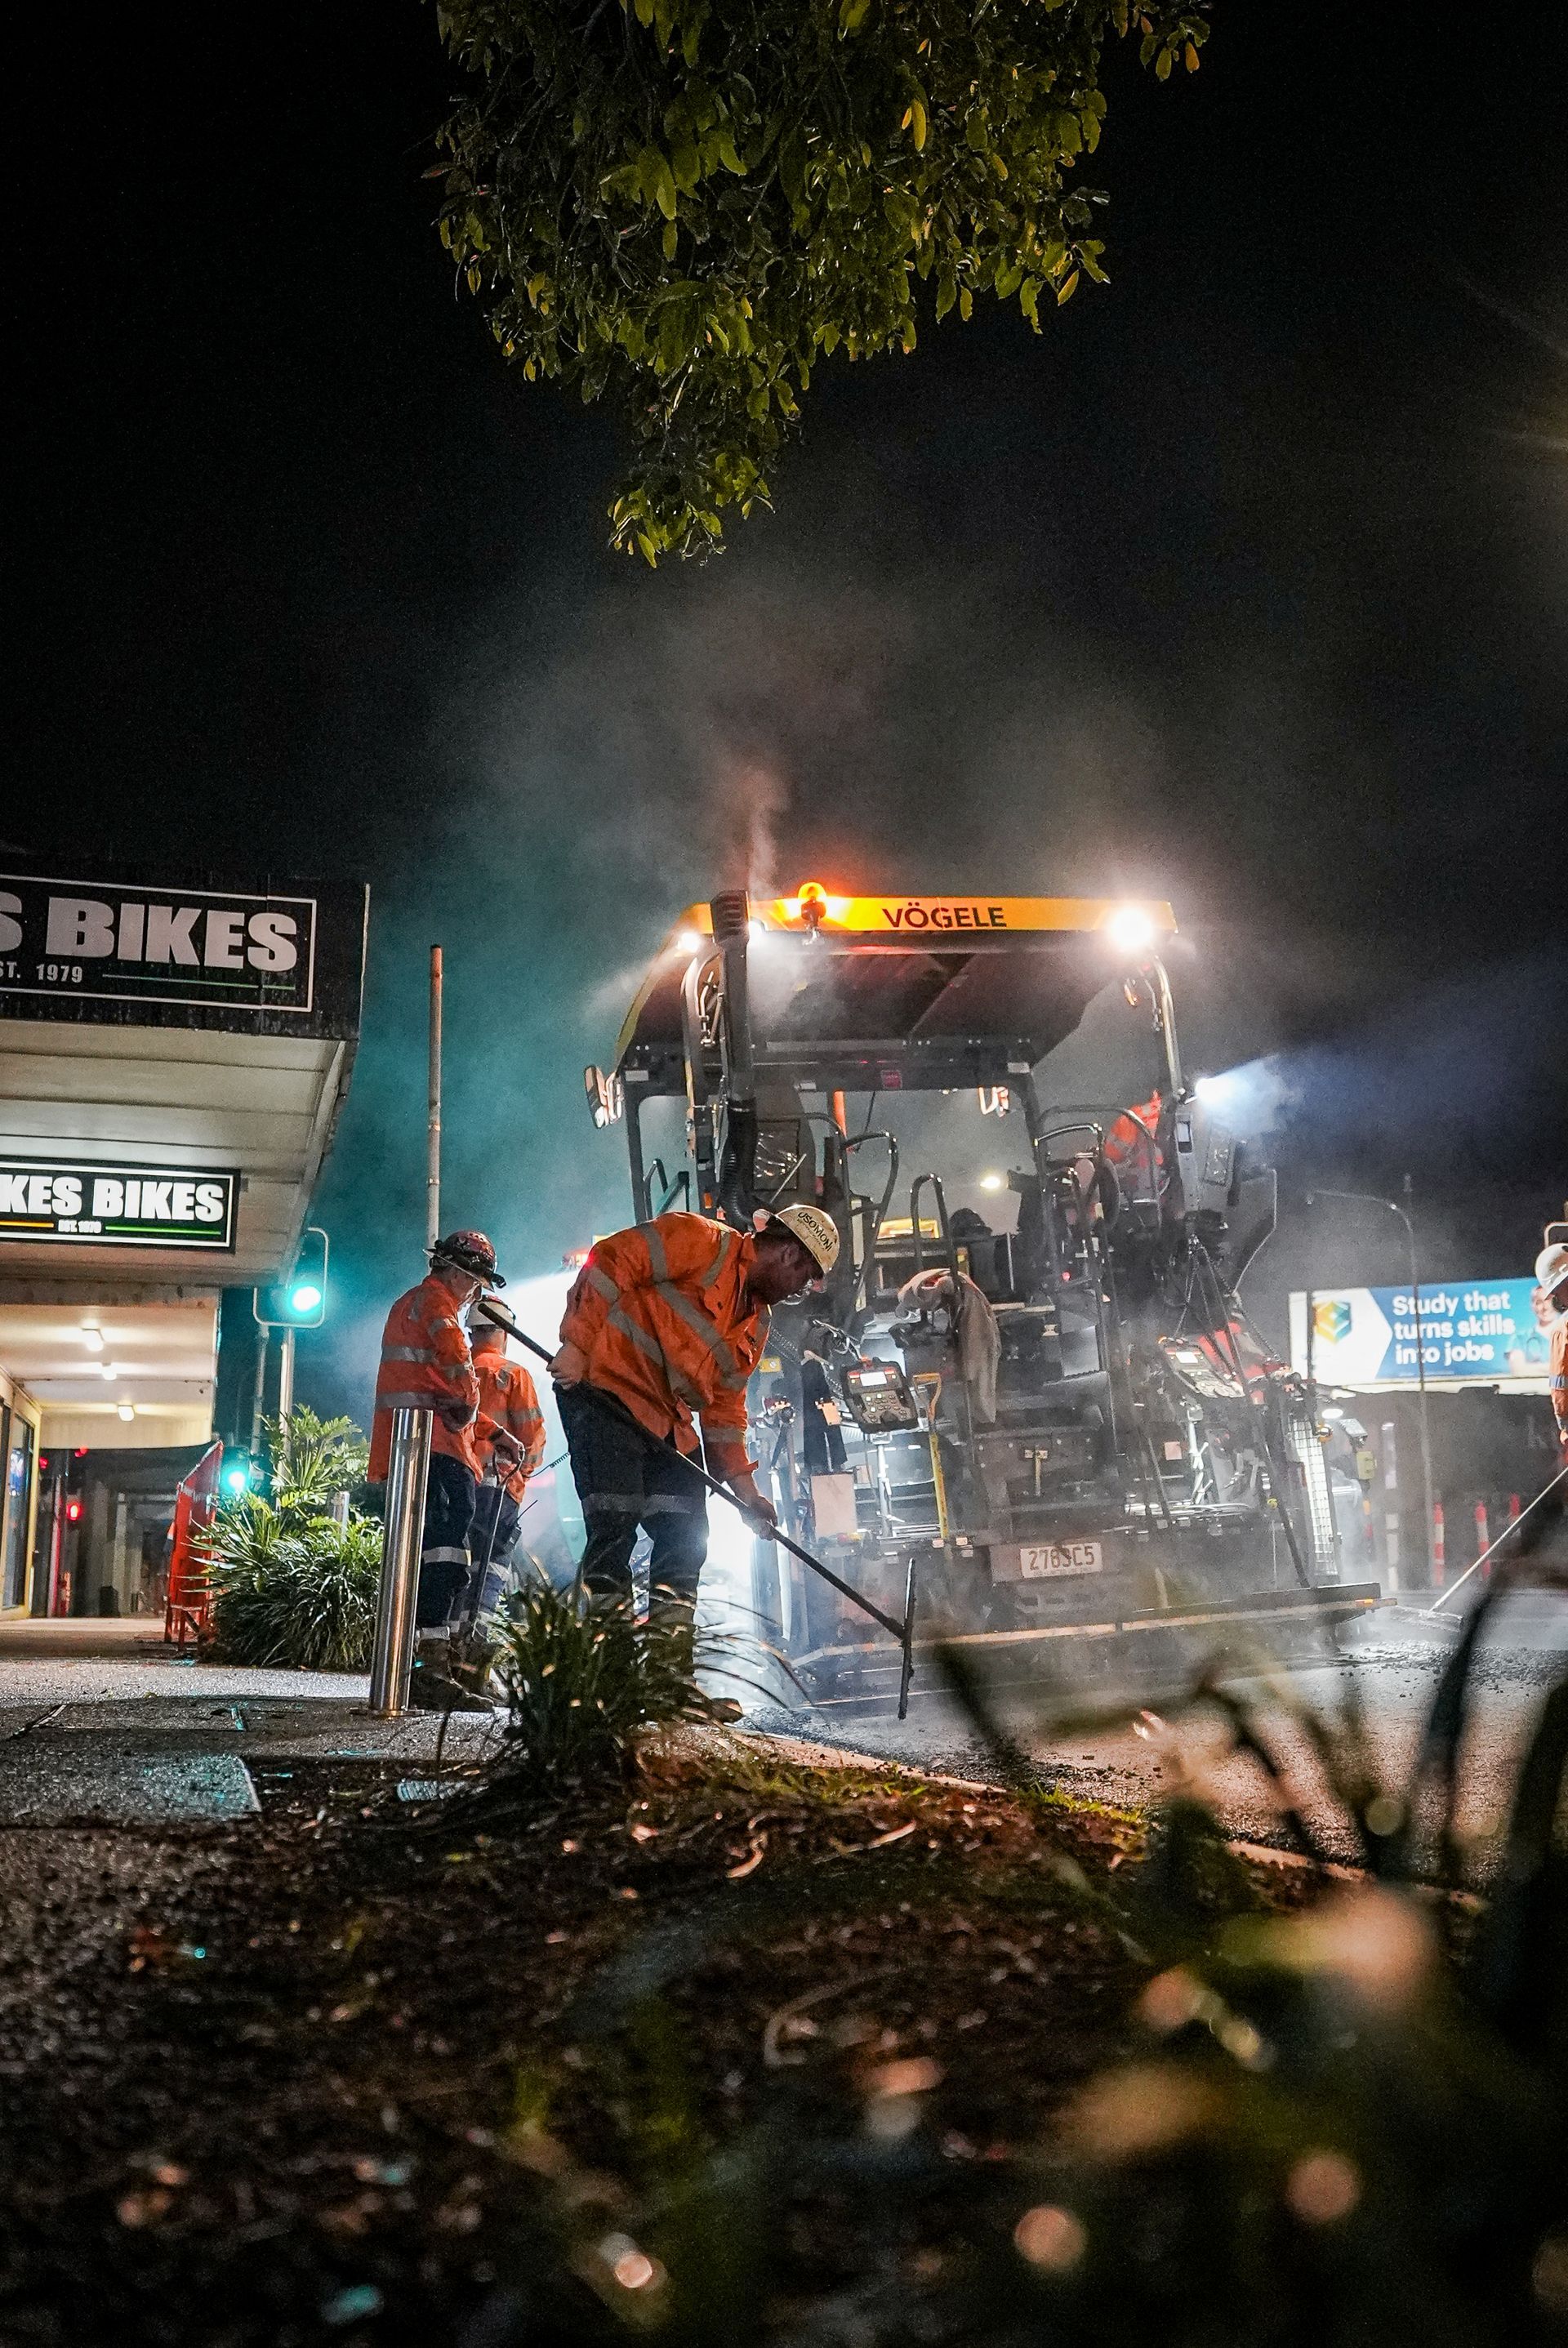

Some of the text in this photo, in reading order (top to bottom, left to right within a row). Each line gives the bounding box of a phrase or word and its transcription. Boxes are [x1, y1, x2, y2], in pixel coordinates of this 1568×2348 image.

[882, 901, 1007, 929] VÖGELE
[46, 897, 297, 972] BIKES
[36, 964, 82, 983] 1979
[0, 1174, 224, 1222] KES BIKES
[1392, 1290, 1511, 1317] Study that
[1394, 1313, 1517, 1340] turns skills
[1444, 1339, 1494, 1366] jobs
